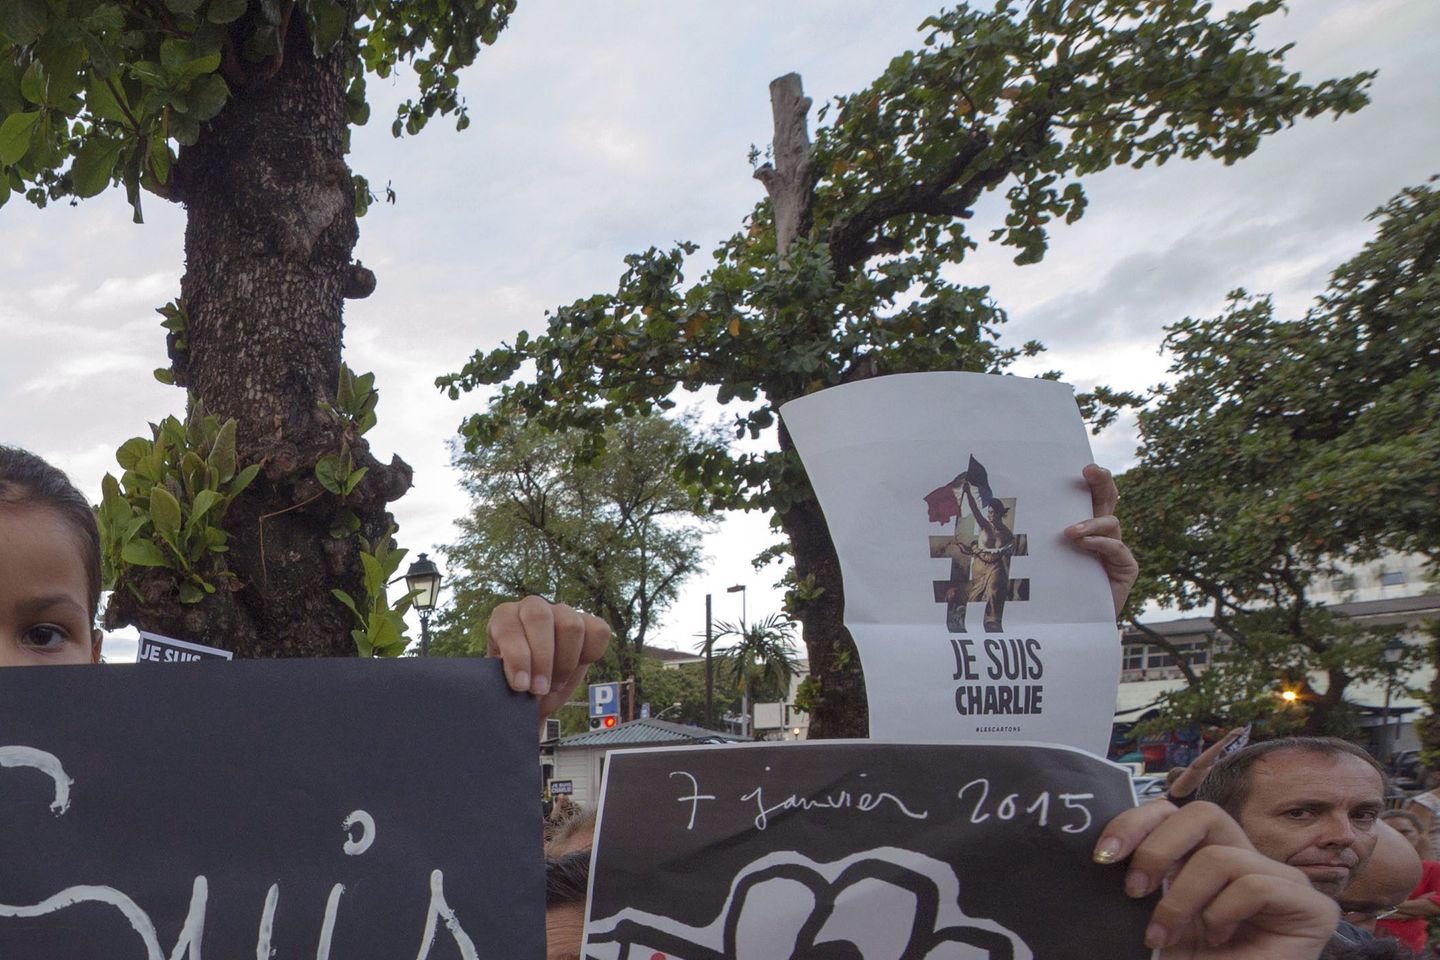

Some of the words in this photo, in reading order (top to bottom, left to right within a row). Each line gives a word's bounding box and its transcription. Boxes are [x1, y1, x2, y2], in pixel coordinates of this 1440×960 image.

[140, 643, 161, 662] JE
[949, 639, 980, 681] JE
[983, 638, 1043, 681] SUIS
[595, 685, 613, 715] P
[955, 685, 1044, 716] CHARLIE
[669, 771, 716, 830] 7
[957, 778, 1094, 833] 2015
